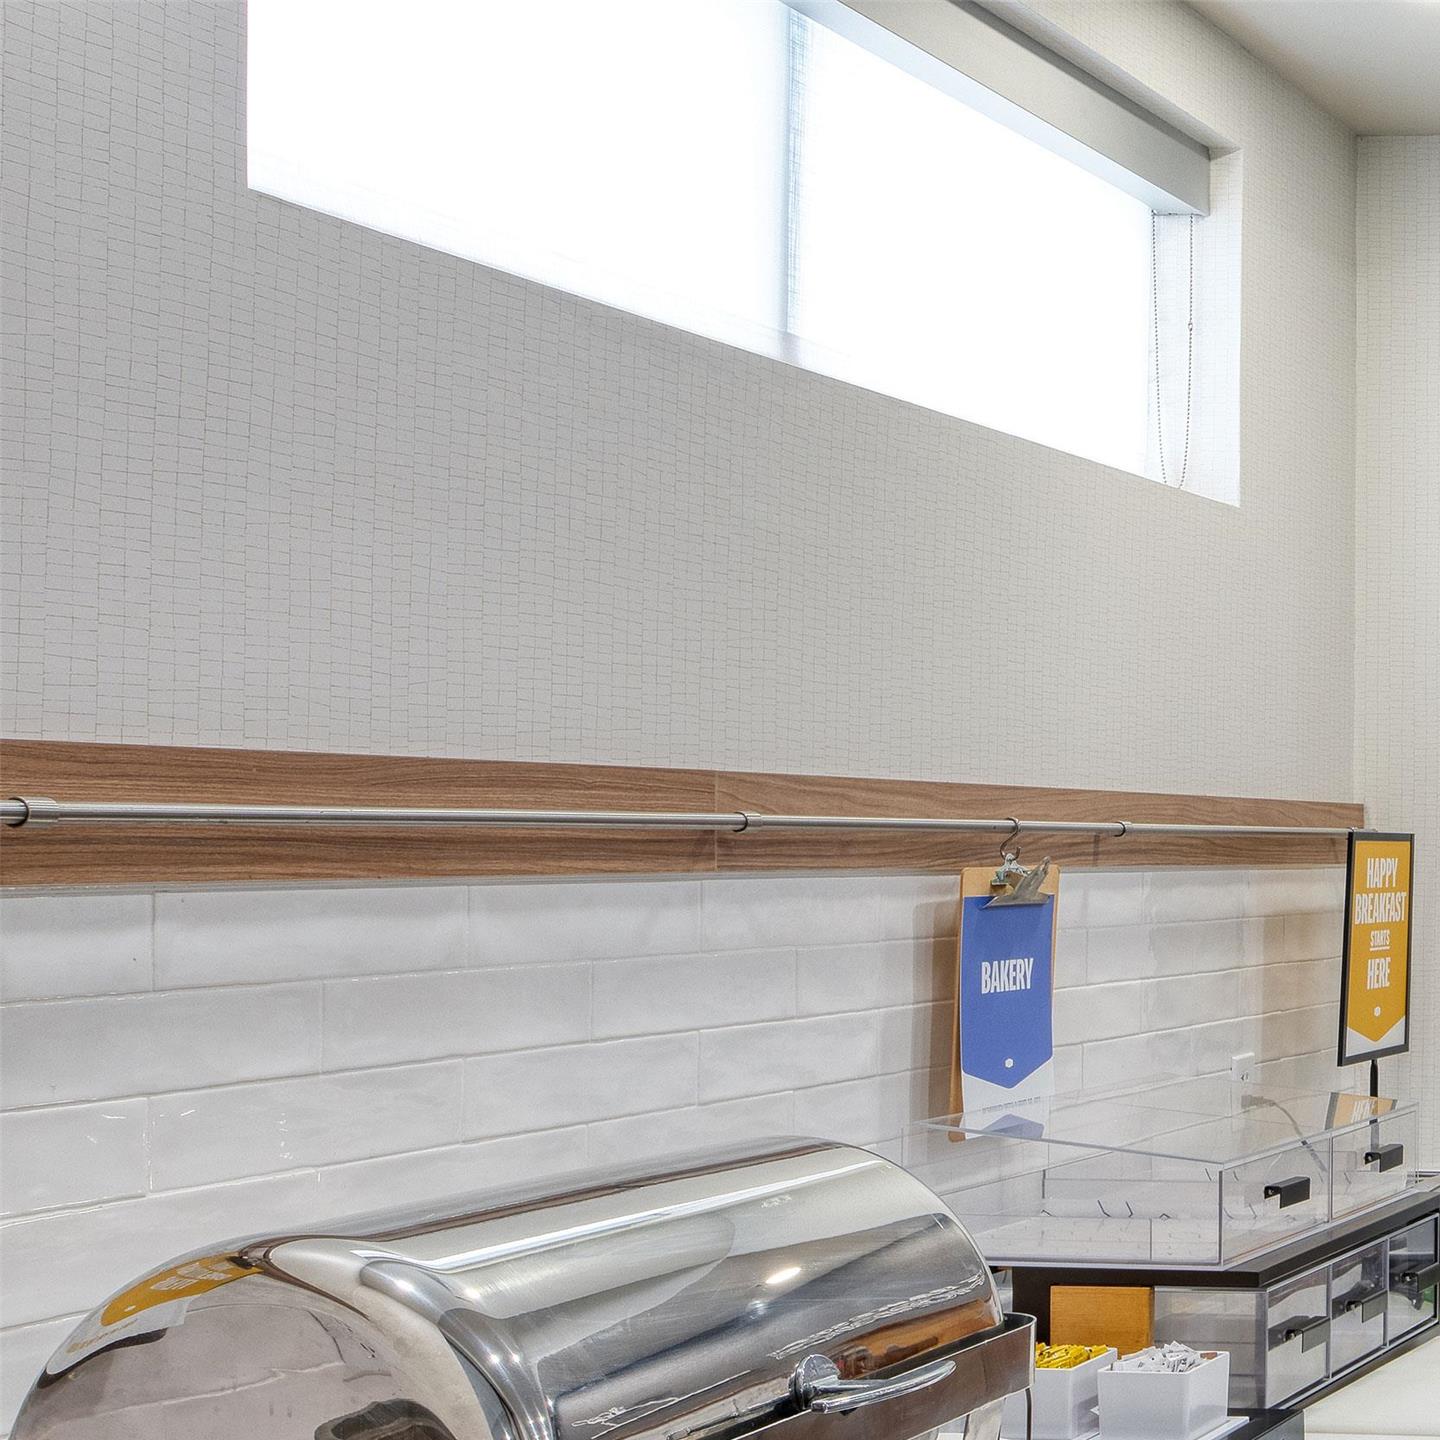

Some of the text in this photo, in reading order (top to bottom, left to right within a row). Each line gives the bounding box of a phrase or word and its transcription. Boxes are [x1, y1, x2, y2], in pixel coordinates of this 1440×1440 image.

[1367, 858, 1399, 889] HAPPY
[1355, 892, 1407, 925] BREAKFAST
[1370, 929, 1391, 946] STARTS
[981, 957, 1034, 995] BAKERY
[1367, 957, 1392, 989] HERE
